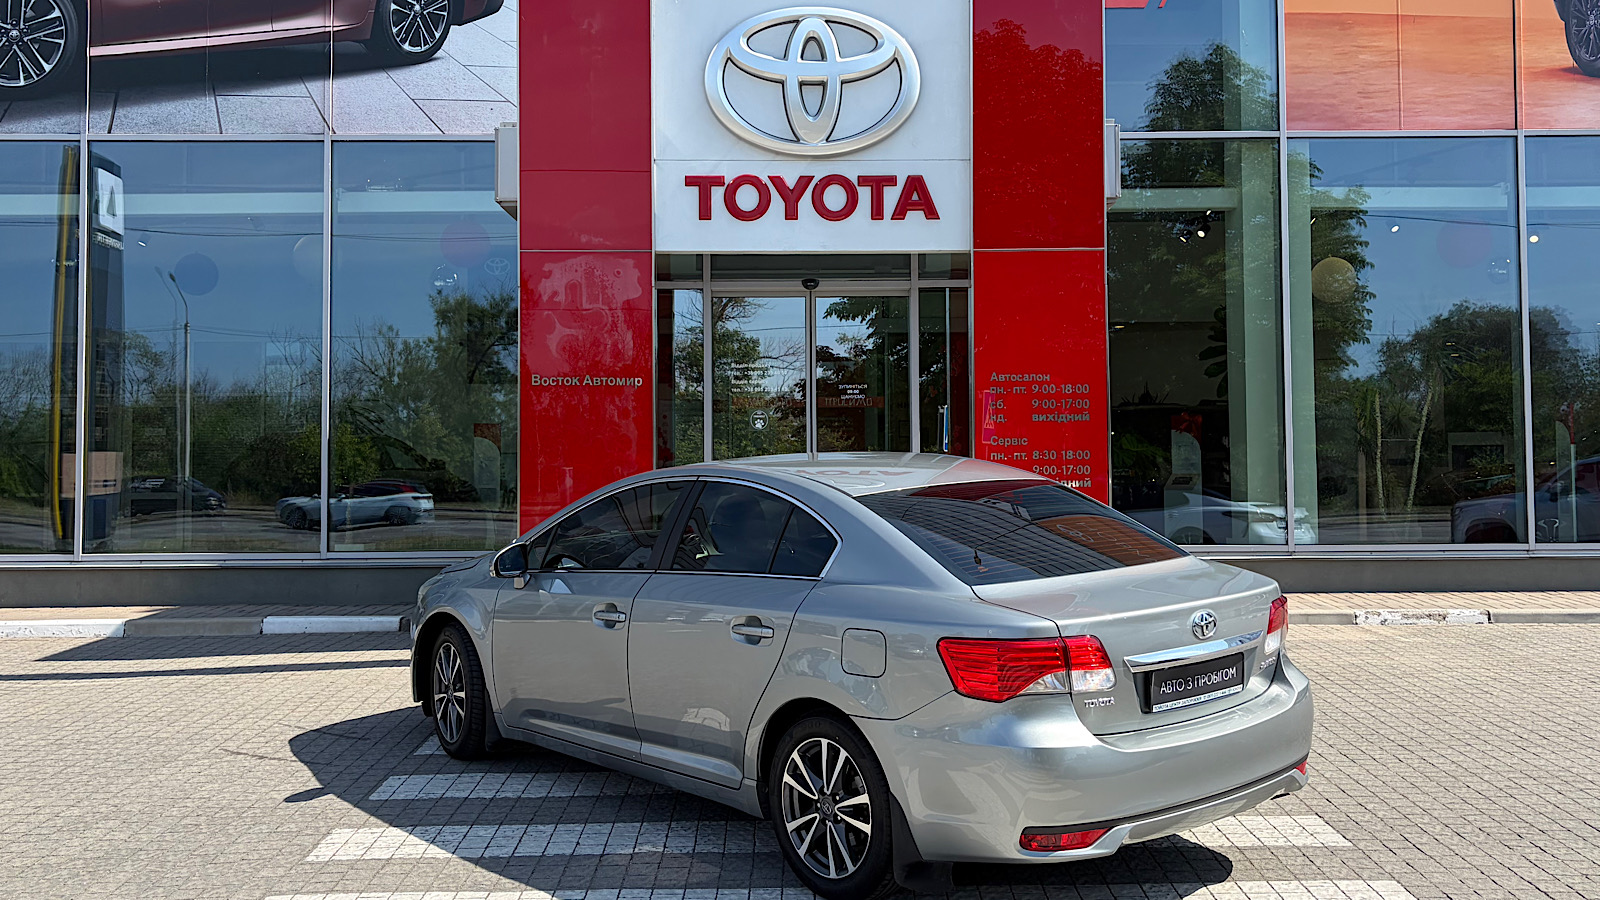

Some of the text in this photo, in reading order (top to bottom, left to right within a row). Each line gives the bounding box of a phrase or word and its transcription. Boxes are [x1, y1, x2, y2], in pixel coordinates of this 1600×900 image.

[685, 174, 940, 221] TOYOTA
[531, 374, 643, 389] Восток Автомир
[990, 372, 1050, 382] Автосалон
[1032, 399, 1090, 409] 9:00-17:00
[1032, 412, 1090, 423] вихідний
[990, 436, 1028, 447] Сервіс
[1033, 465, 1091, 475] 9:00-17:00
[1160, 679, 1185, 695] АВТО
[1194, 666, 1237, 688] ПРОБІГОМ
[1084, 697, 1115, 708] TOYOTA
